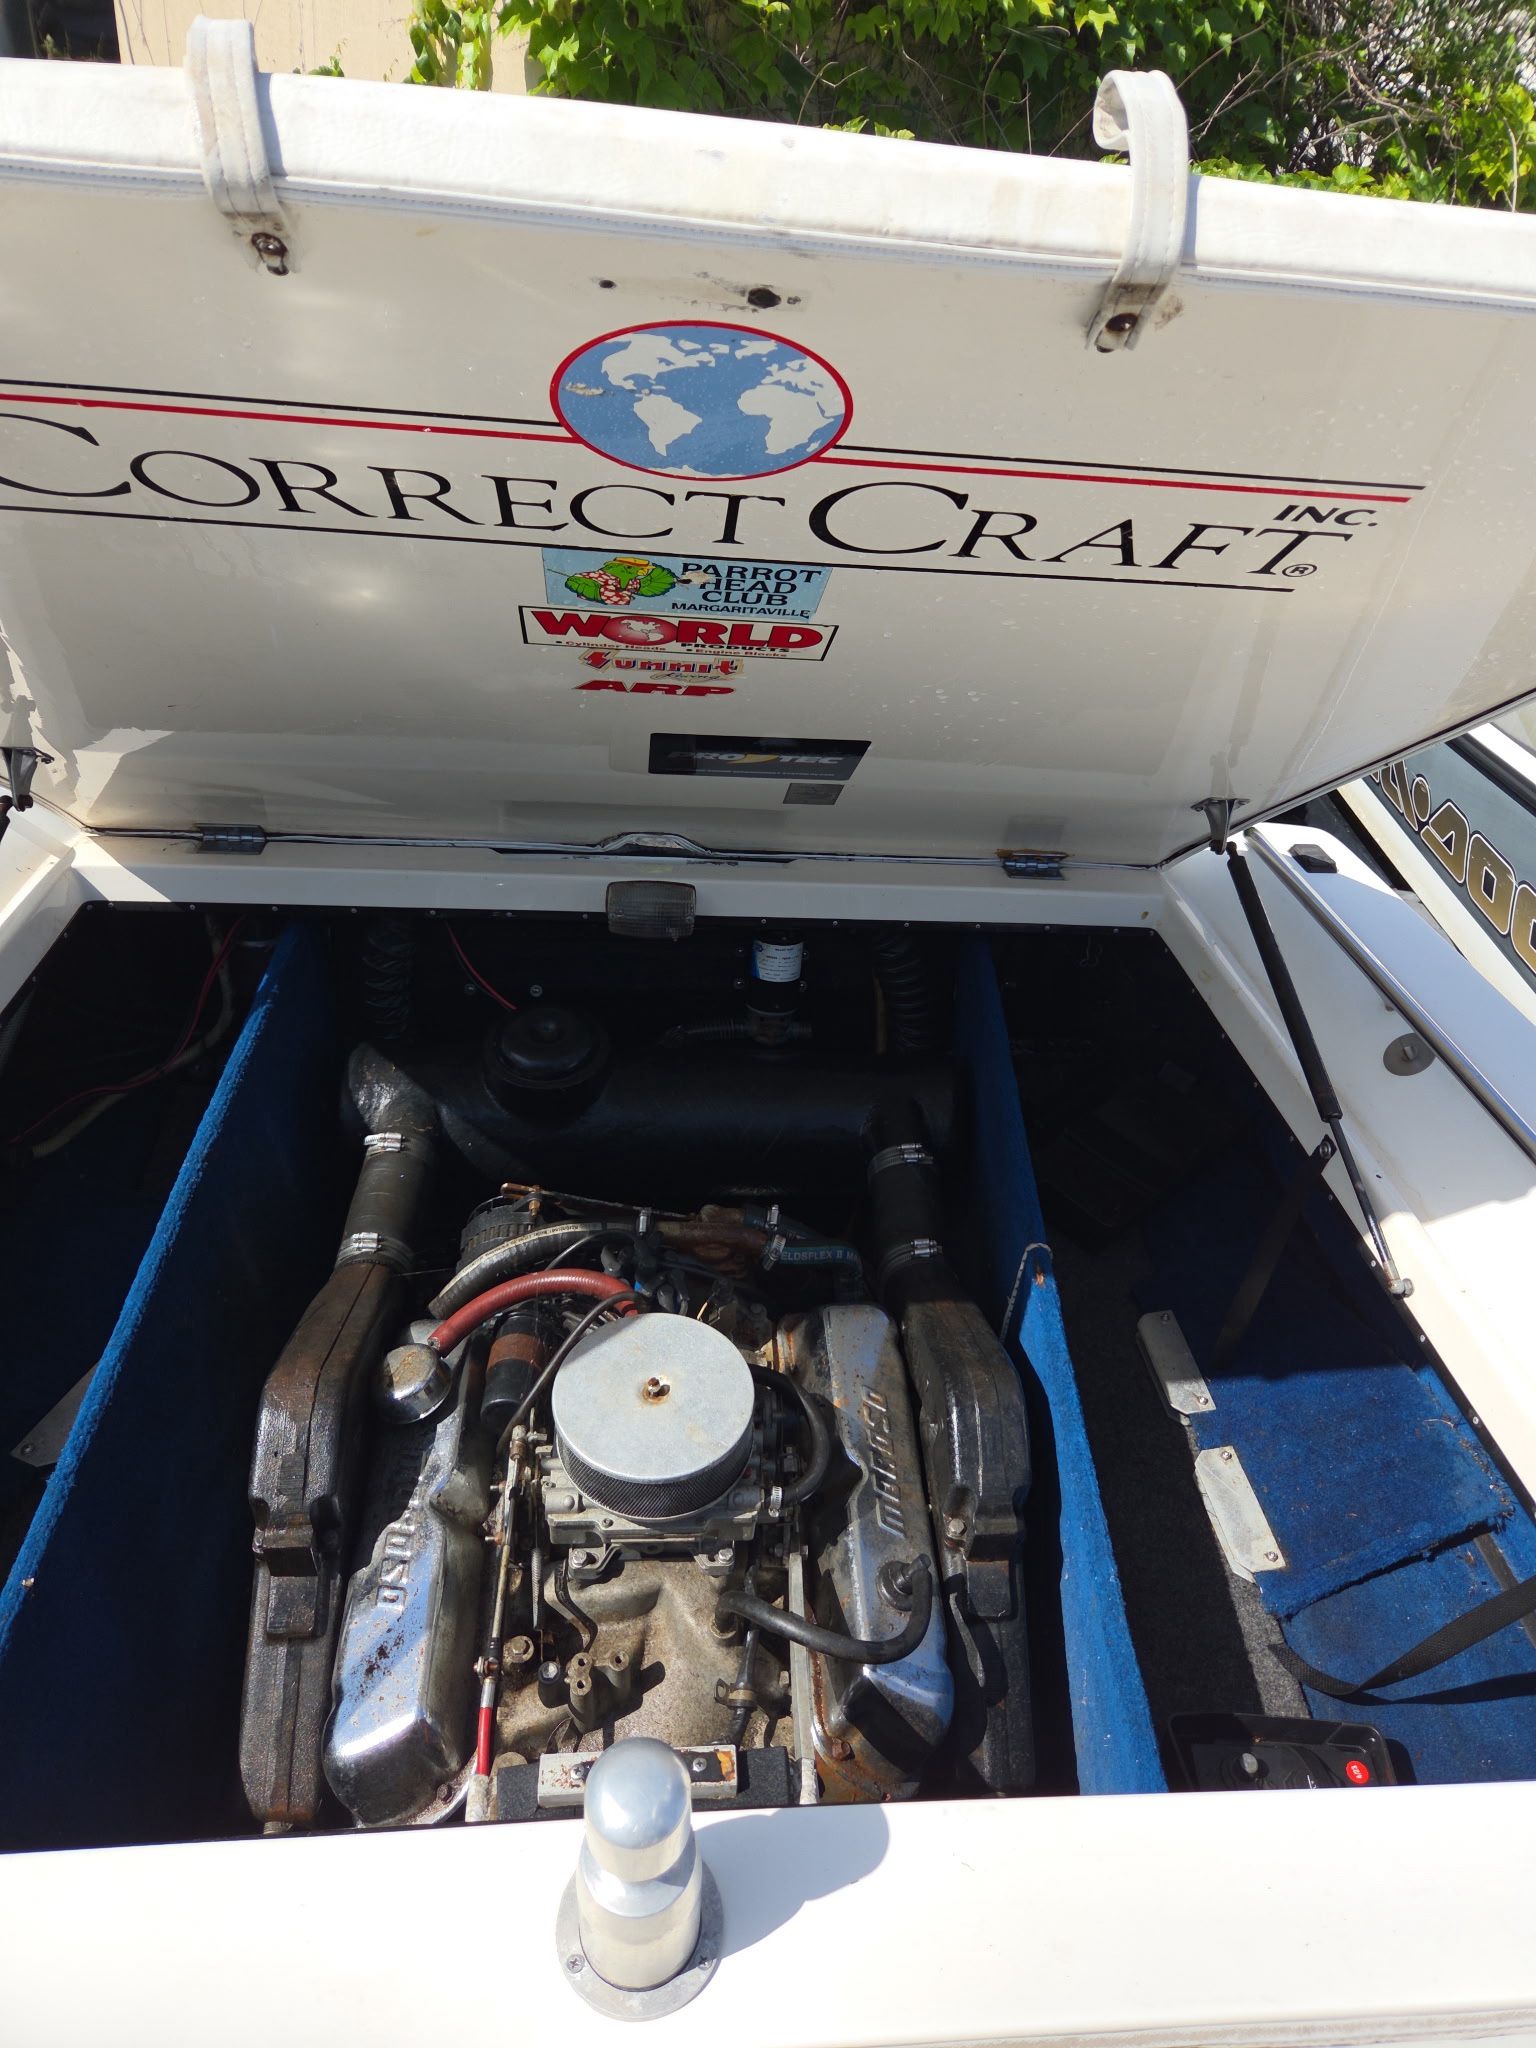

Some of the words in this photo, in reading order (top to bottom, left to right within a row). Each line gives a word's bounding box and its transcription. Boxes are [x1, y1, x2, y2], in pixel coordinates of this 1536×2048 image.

[1273, 504, 1378, 527] INC.
[682, 562, 821, 583] PARROT
[699, 578, 797, 594] HEAD
[701, 591, 788, 606] CLUB
[671, 602, 810, 619] MARGARITAVILLE
[531, 610, 824, 649] WORLD
[680, 642, 790, 653] PRODUCTS
[572, 679, 736, 697] ARP
[781, 1249, 833, 1262] ELDSFLEX
